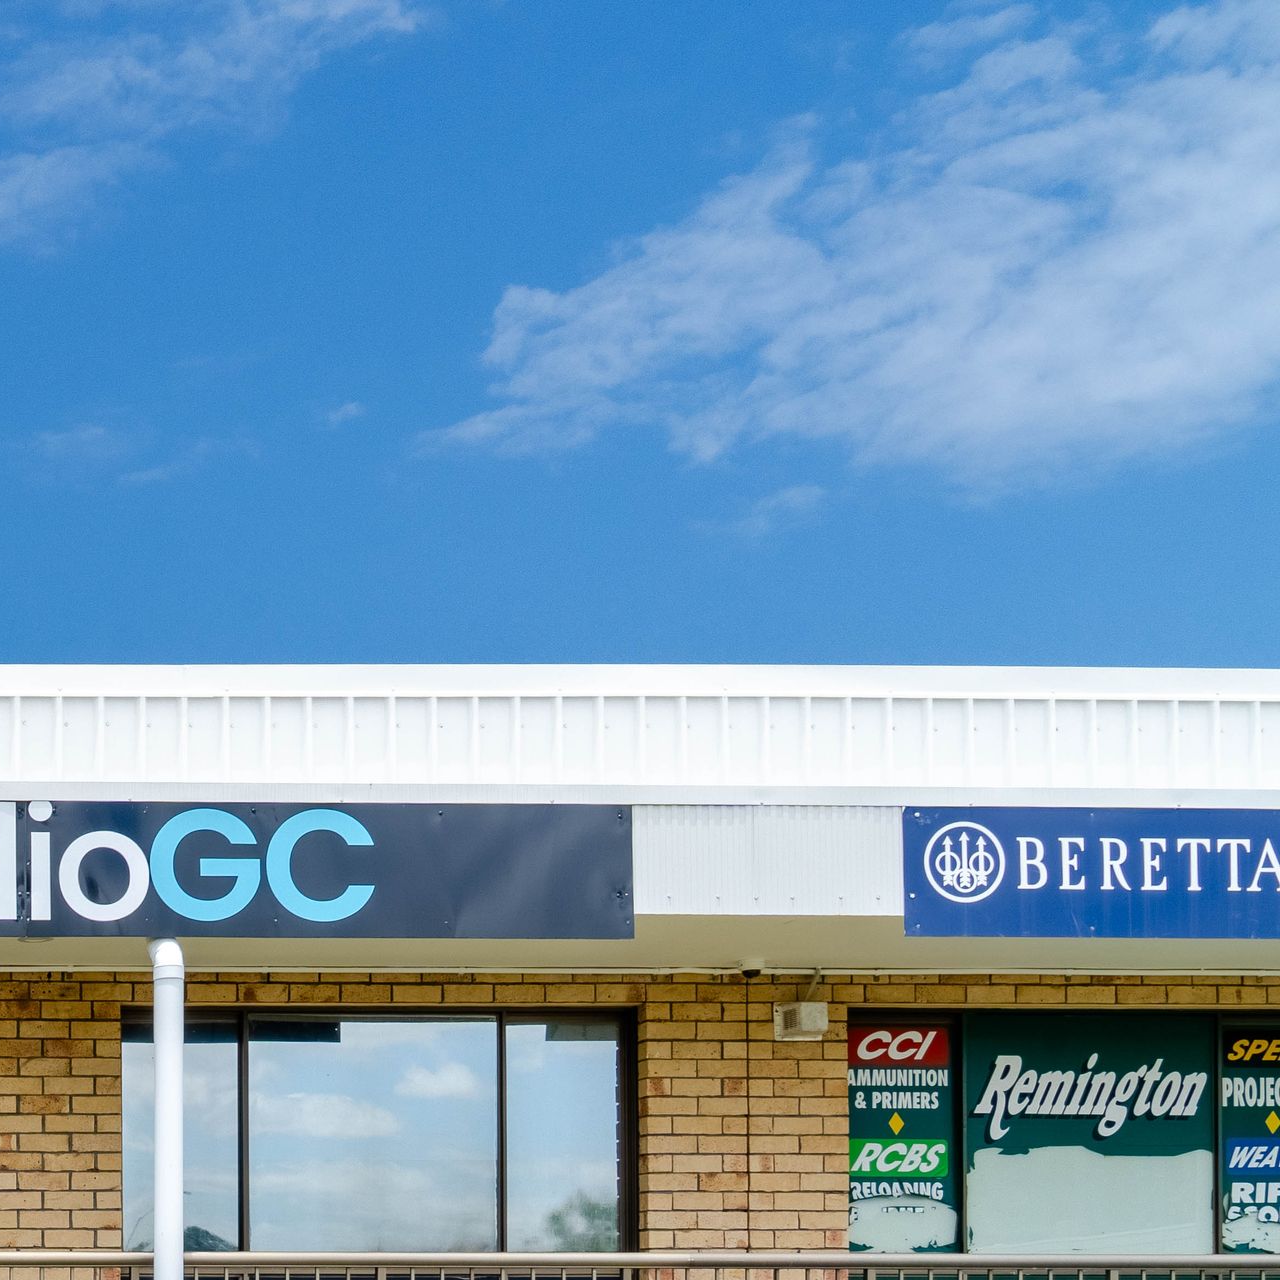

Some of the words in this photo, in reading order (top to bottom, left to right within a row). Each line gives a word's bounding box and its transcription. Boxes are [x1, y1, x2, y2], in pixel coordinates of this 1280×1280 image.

[1016, 836, 1280, 892] BERETTA
[857, 1031, 937, 1060] CCI
[1228, 1039, 1280, 1061] SPE
[848, 1069, 948, 1087] AMMUNITION
[854, 1092, 866, 1109] &
[872, 1091, 939, 1109] PRIMERS
[973, 1053, 1207, 1141] Remington
[851, 1143, 946, 1172] RCBS
[1229, 1146, 1280, 1168] WEA
